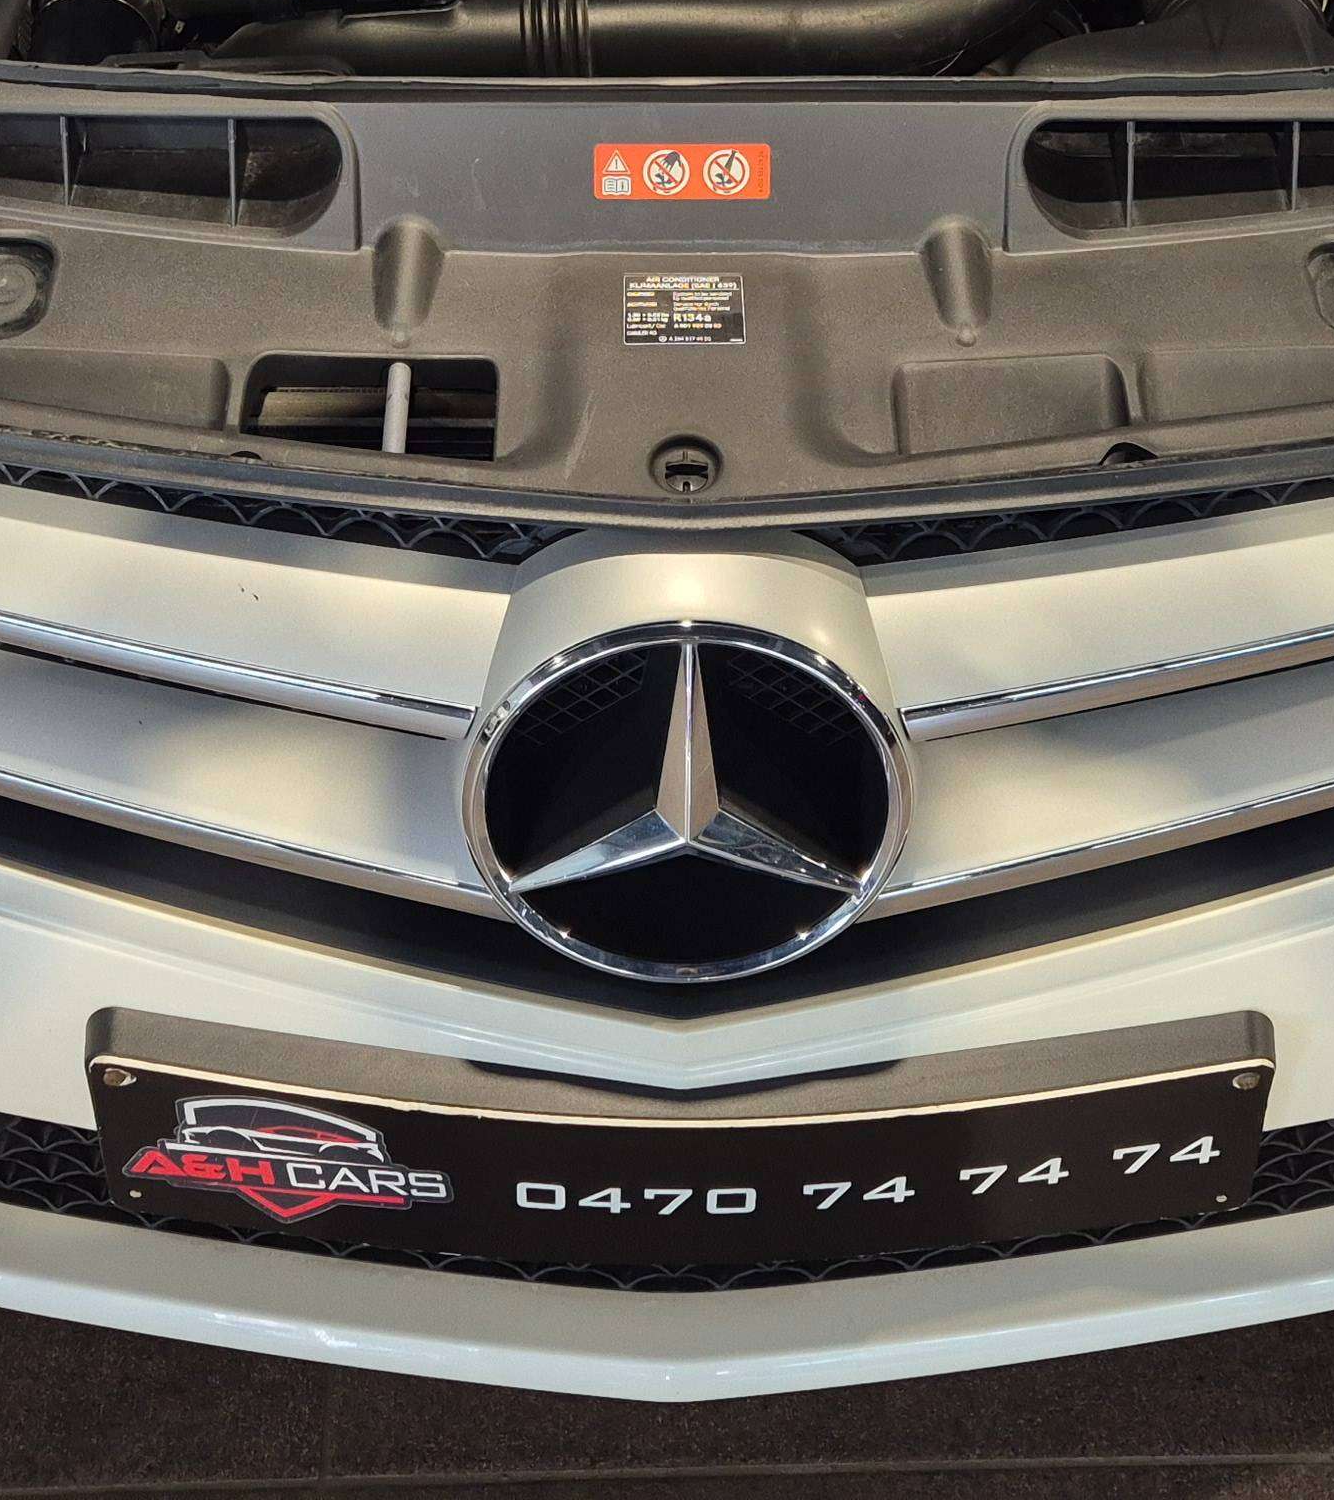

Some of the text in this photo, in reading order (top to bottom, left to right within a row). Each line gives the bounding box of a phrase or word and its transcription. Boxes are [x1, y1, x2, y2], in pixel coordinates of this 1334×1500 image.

[673, 313, 712, 322] R134a
[130, 1149, 448, 1199] A&H CARS
[516, 1135, 1221, 1215] 0470 74 74 74
